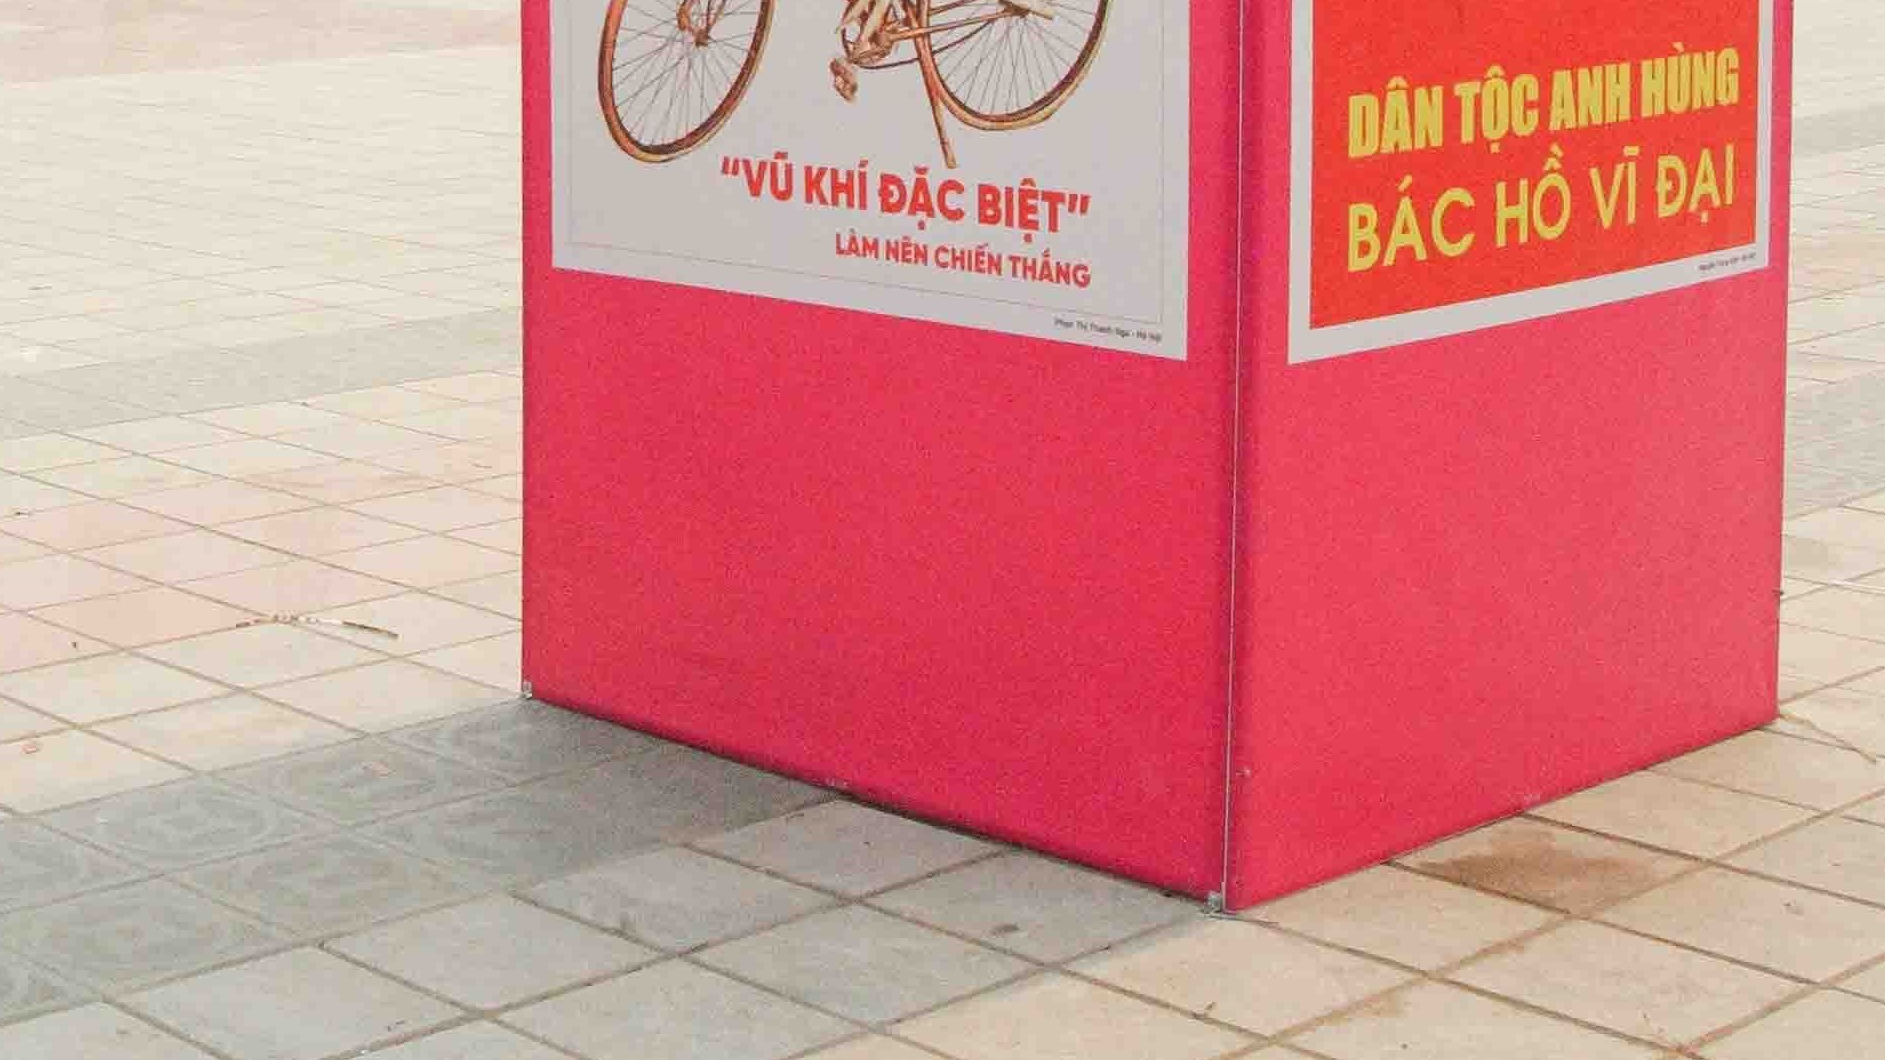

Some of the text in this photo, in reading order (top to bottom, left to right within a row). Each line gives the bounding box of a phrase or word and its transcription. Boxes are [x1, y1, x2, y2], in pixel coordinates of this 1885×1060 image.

[1348, 41, 1740, 159] DÂN TỘC ANH HÙNG
[803, 159, 869, 211] KHÍ
[877, 166, 966, 231] ĐẶC
[1348, 142, 1736, 273] BÁC HỒ VĨ ĐẠI
[834, 227, 1092, 289] LÀM NÊN CHIẾN THẮNG
